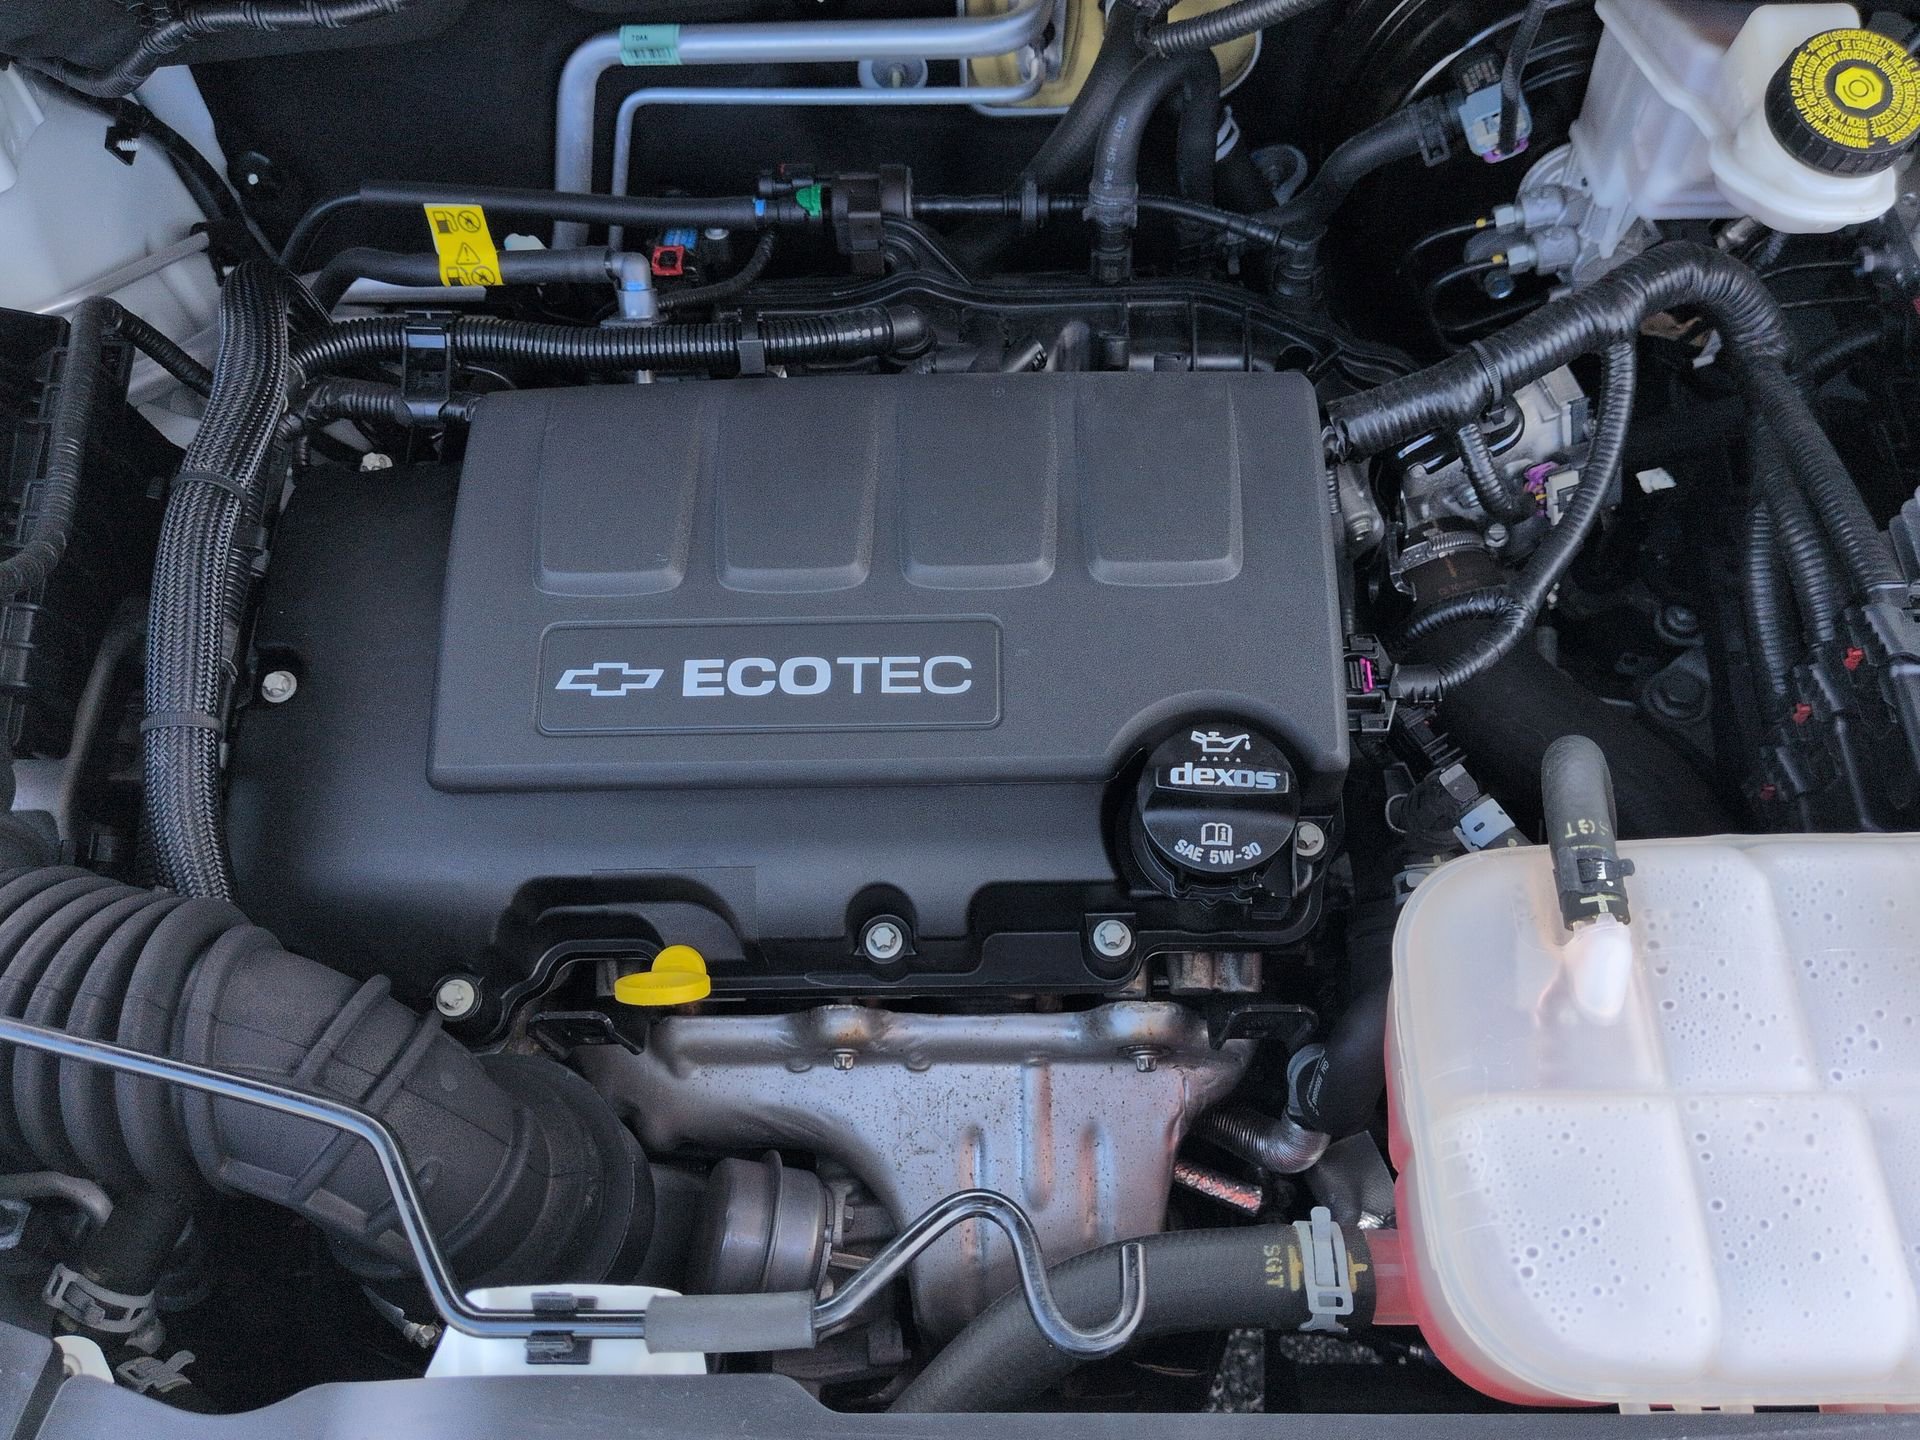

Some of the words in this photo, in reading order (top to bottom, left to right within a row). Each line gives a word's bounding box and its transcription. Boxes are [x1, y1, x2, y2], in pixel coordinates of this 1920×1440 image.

[1790, 51, 1810, 80] BEFORE
[1790, 79, 1805, 103] CAP
[1795, 101, 1817, 124] FILLER
[1810, 104, 1829, 122] USE
[1837, 113, 1848, 124] A
[682, 656, 973, 697] ECOTEC
[1170, 762, 1278, 790] dexos
[1174, 839, 1204, 862] SAE
[1209, 842, 1262, 865] 5W-30
